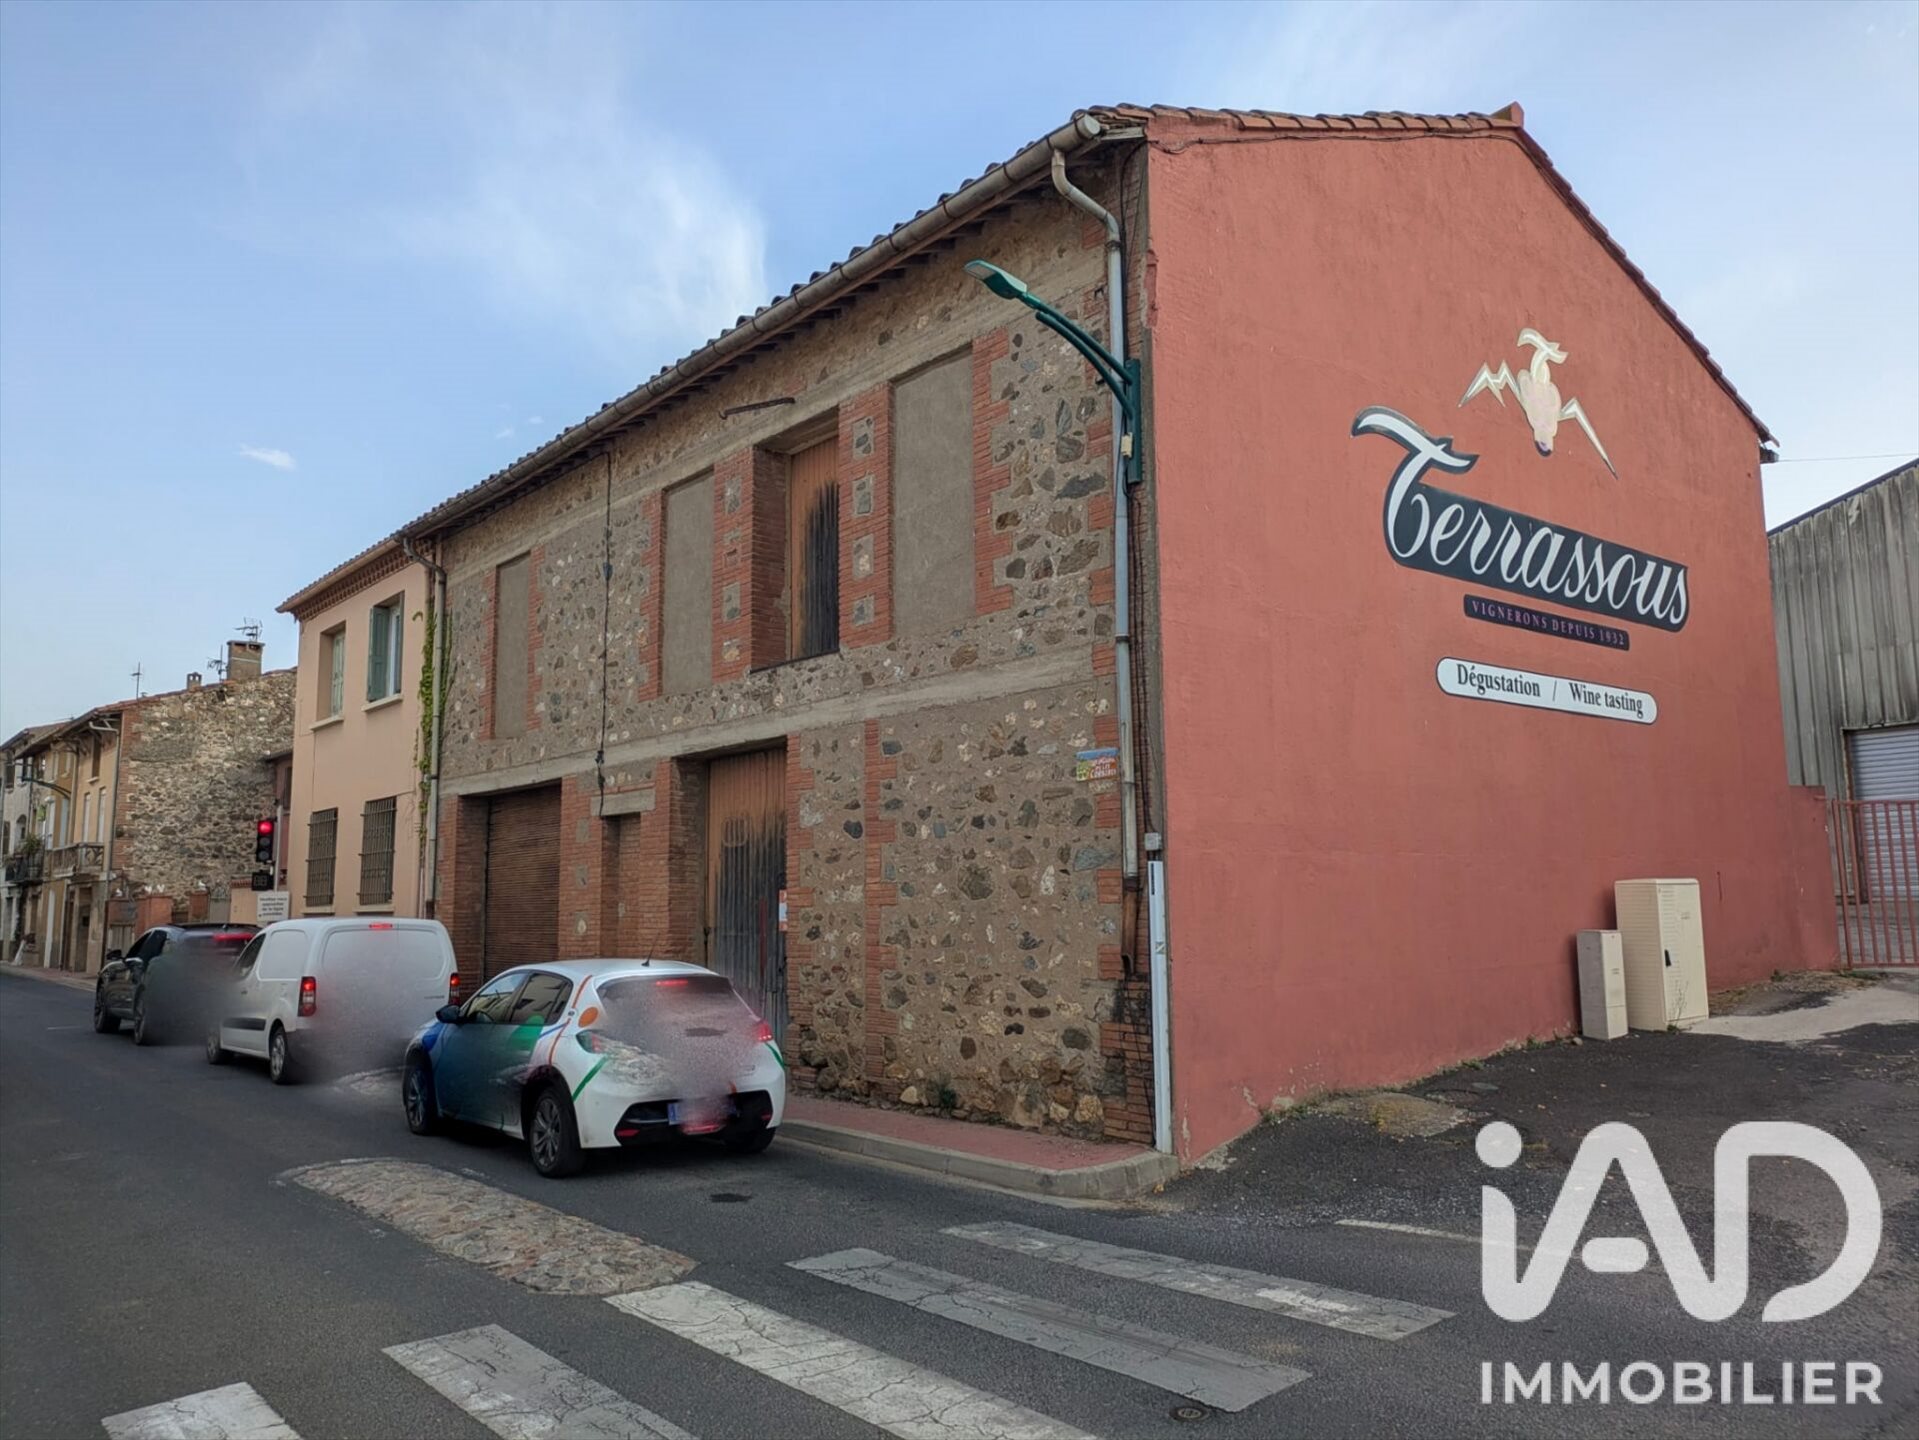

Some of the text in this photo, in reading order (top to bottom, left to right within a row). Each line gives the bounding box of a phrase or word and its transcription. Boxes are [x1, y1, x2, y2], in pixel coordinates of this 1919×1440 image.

[1353, 408, 1688, 625] Terrassous
[1472, 600, 1625, 646] VIGNERONS DEPUIS 1932
[1456, 663, 1541, 697] Dégustation
[1568, 682, 1602, 706] Wine
[1604, 692, 1644, 719] tasting
